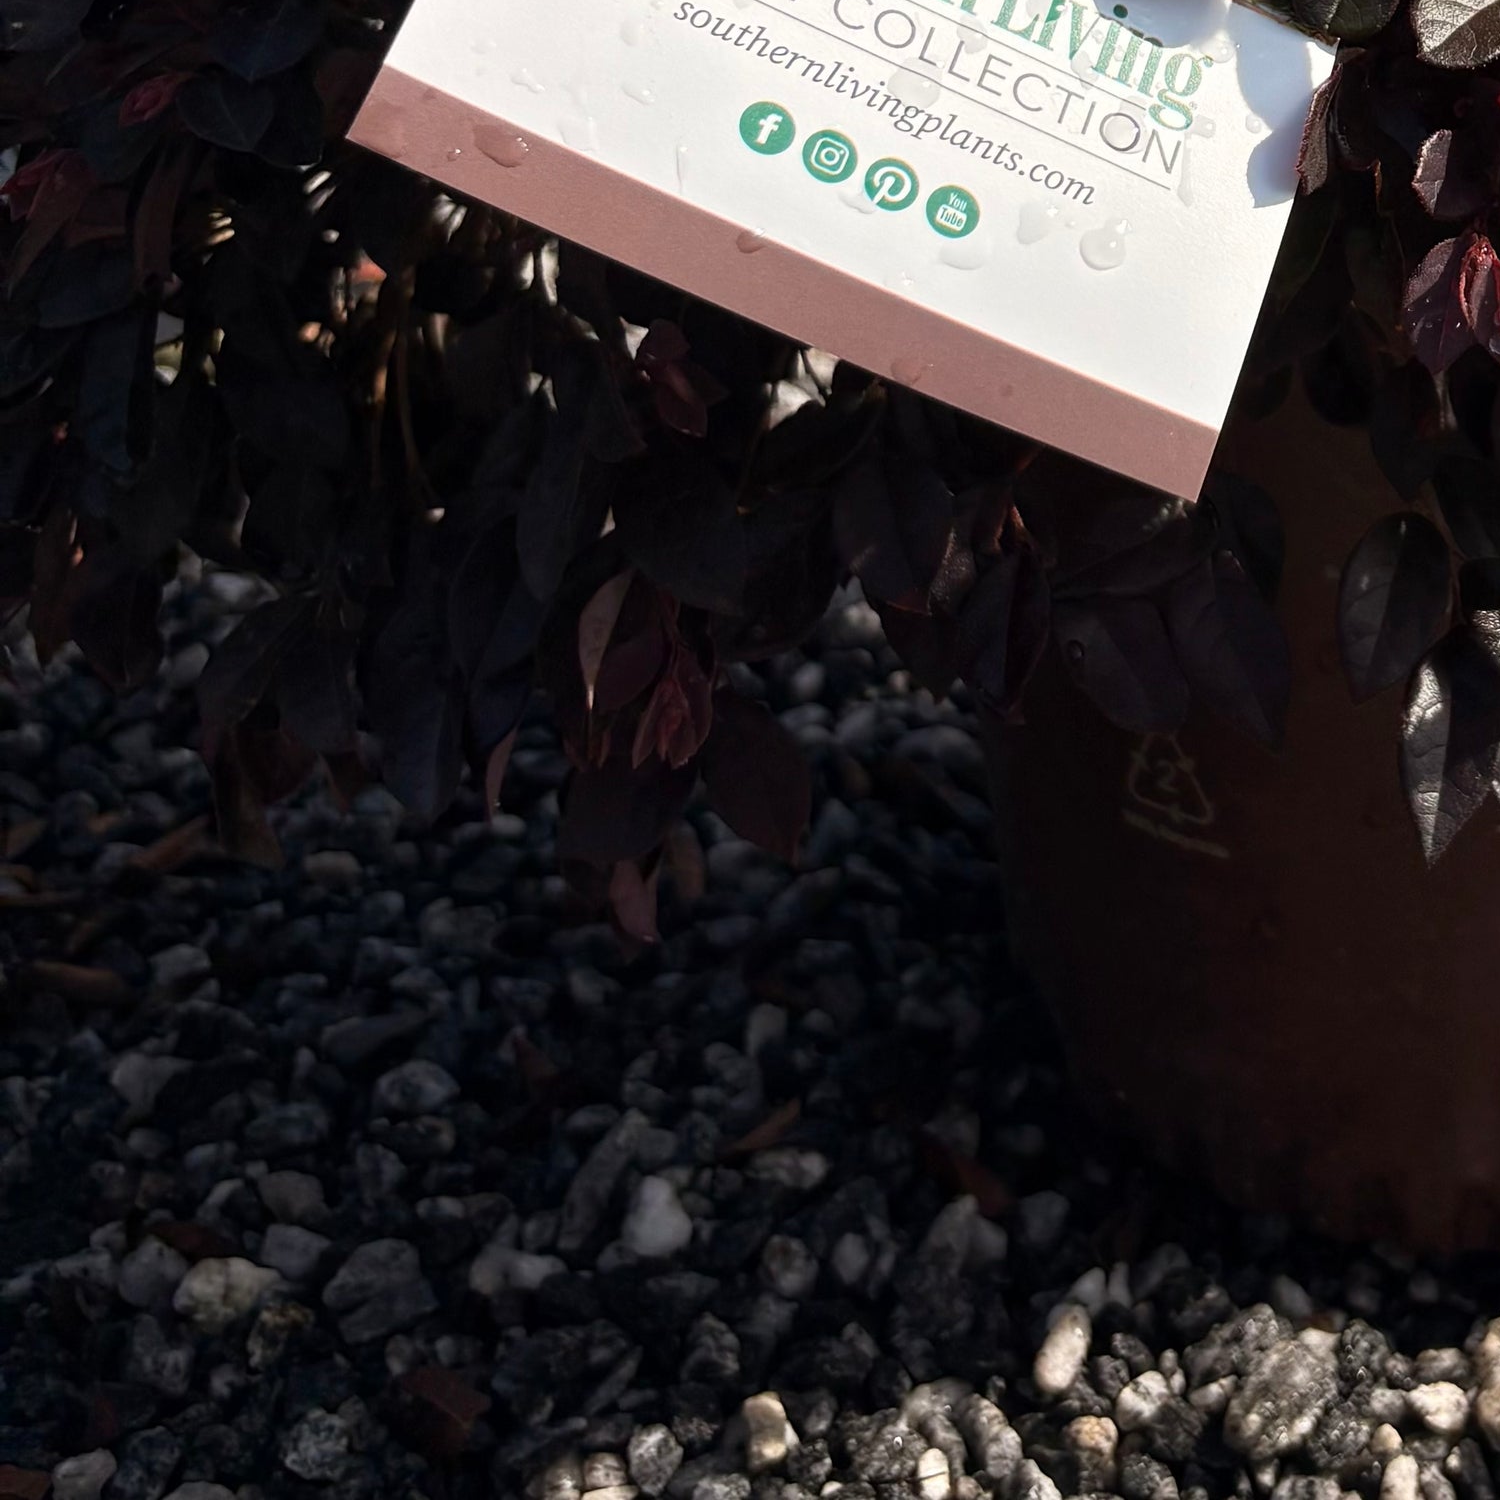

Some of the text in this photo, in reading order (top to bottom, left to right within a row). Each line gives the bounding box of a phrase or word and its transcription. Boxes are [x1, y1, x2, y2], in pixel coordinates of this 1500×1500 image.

[673, 0, 1096, 206] southernlivingplants.com
[949, 193, 967, 211] You
[940, 208, 964, 227] Tube
